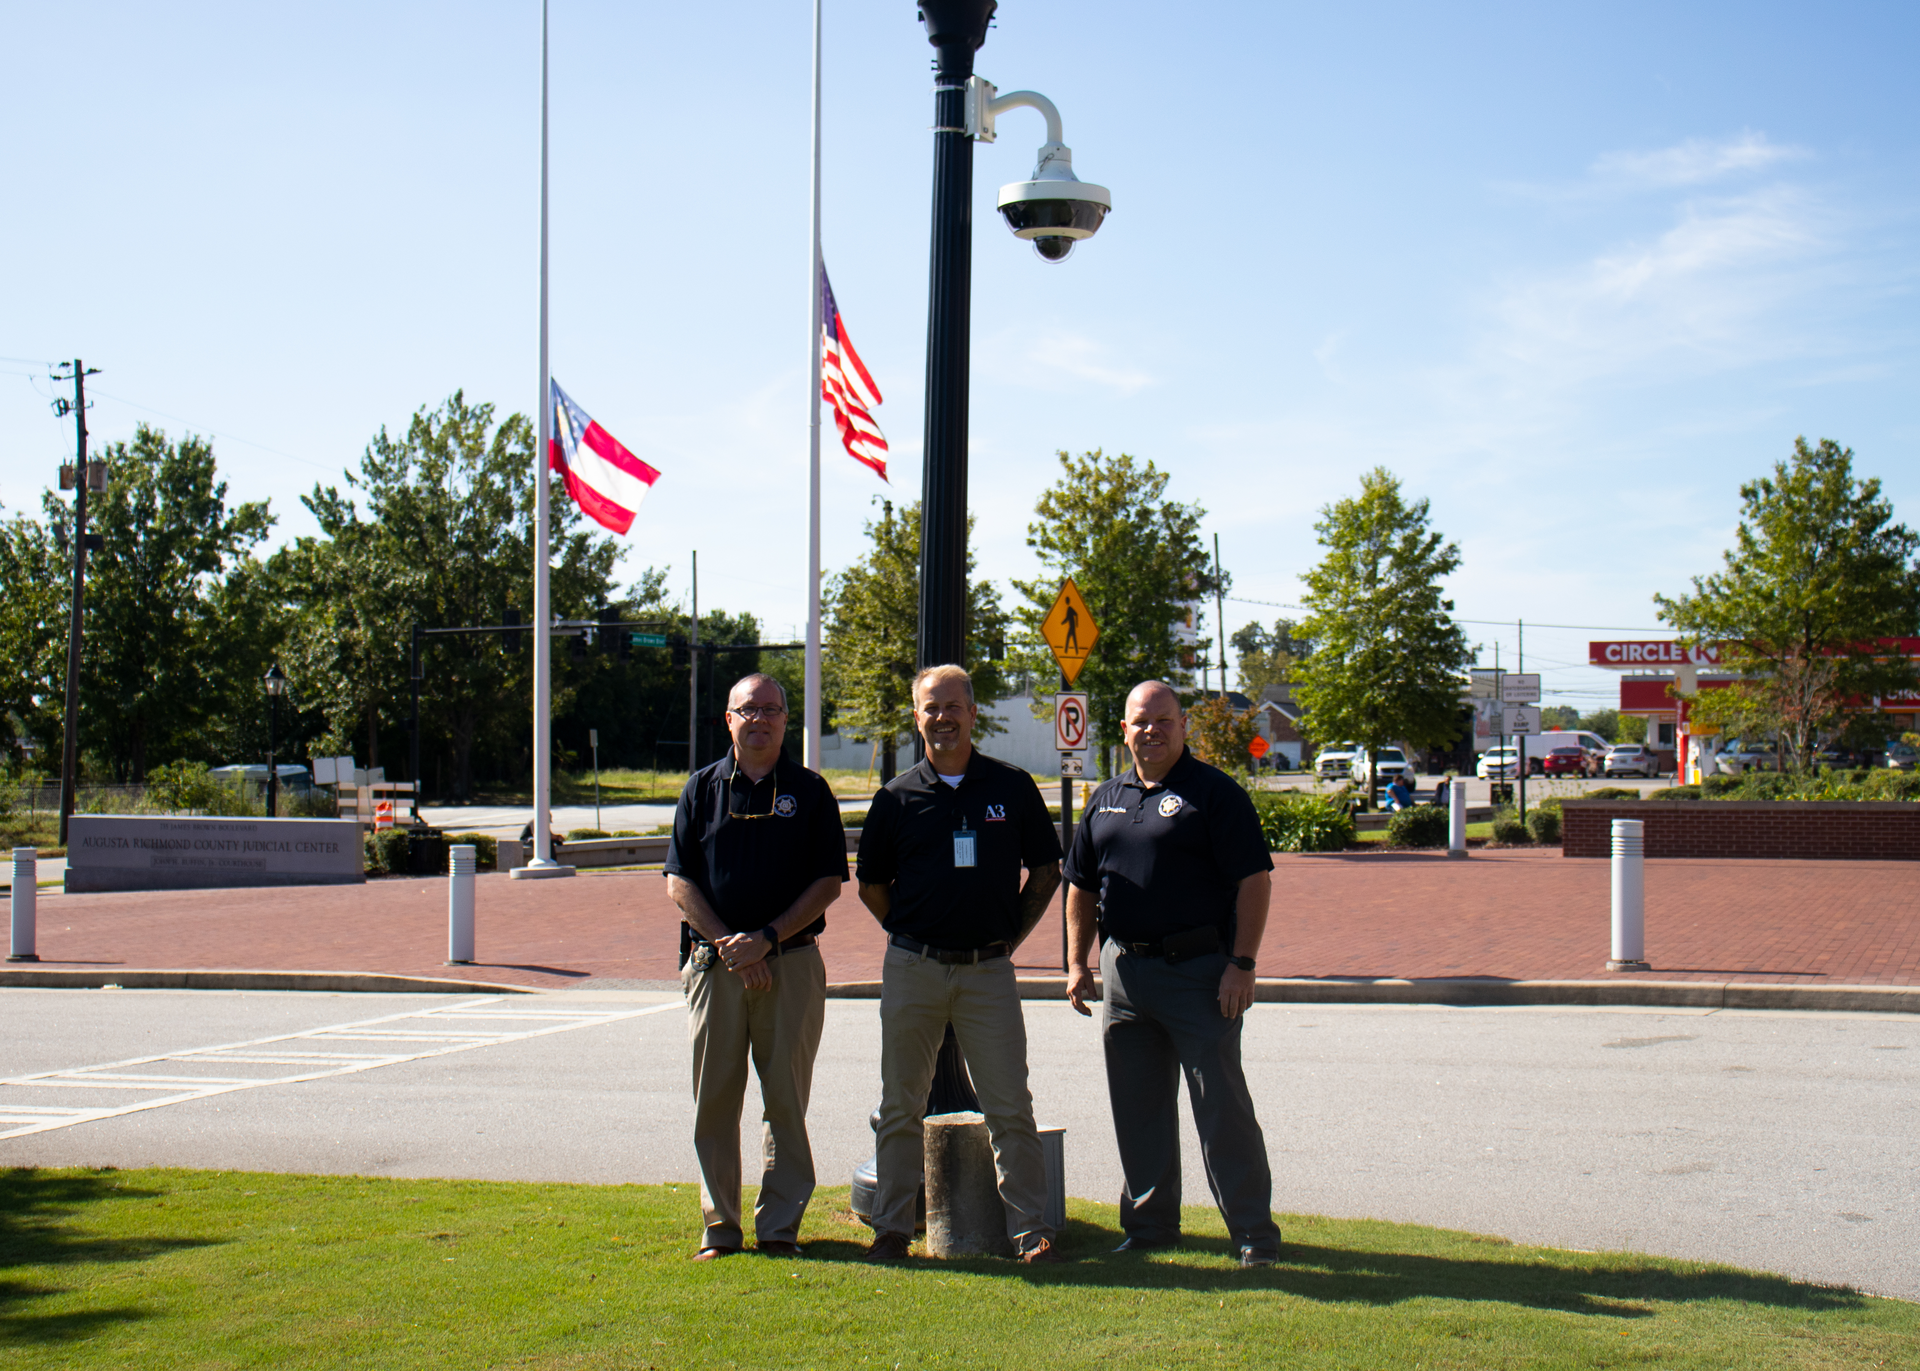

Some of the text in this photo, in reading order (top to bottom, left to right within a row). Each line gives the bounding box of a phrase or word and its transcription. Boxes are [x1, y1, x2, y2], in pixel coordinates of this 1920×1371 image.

[1605, 643, 1683, 662] CIRCLE
[985, 804, 1006, 818] A3
[170, 823, 191, 831] JAMES
[218, 824, 258, 832] BOULEVARD
[82, 837, 340, 854] AUGUSTA RICHMOND COUNTY JUDICIAL CENTER
[218, 859, 262, 868] COURTHOUSE
